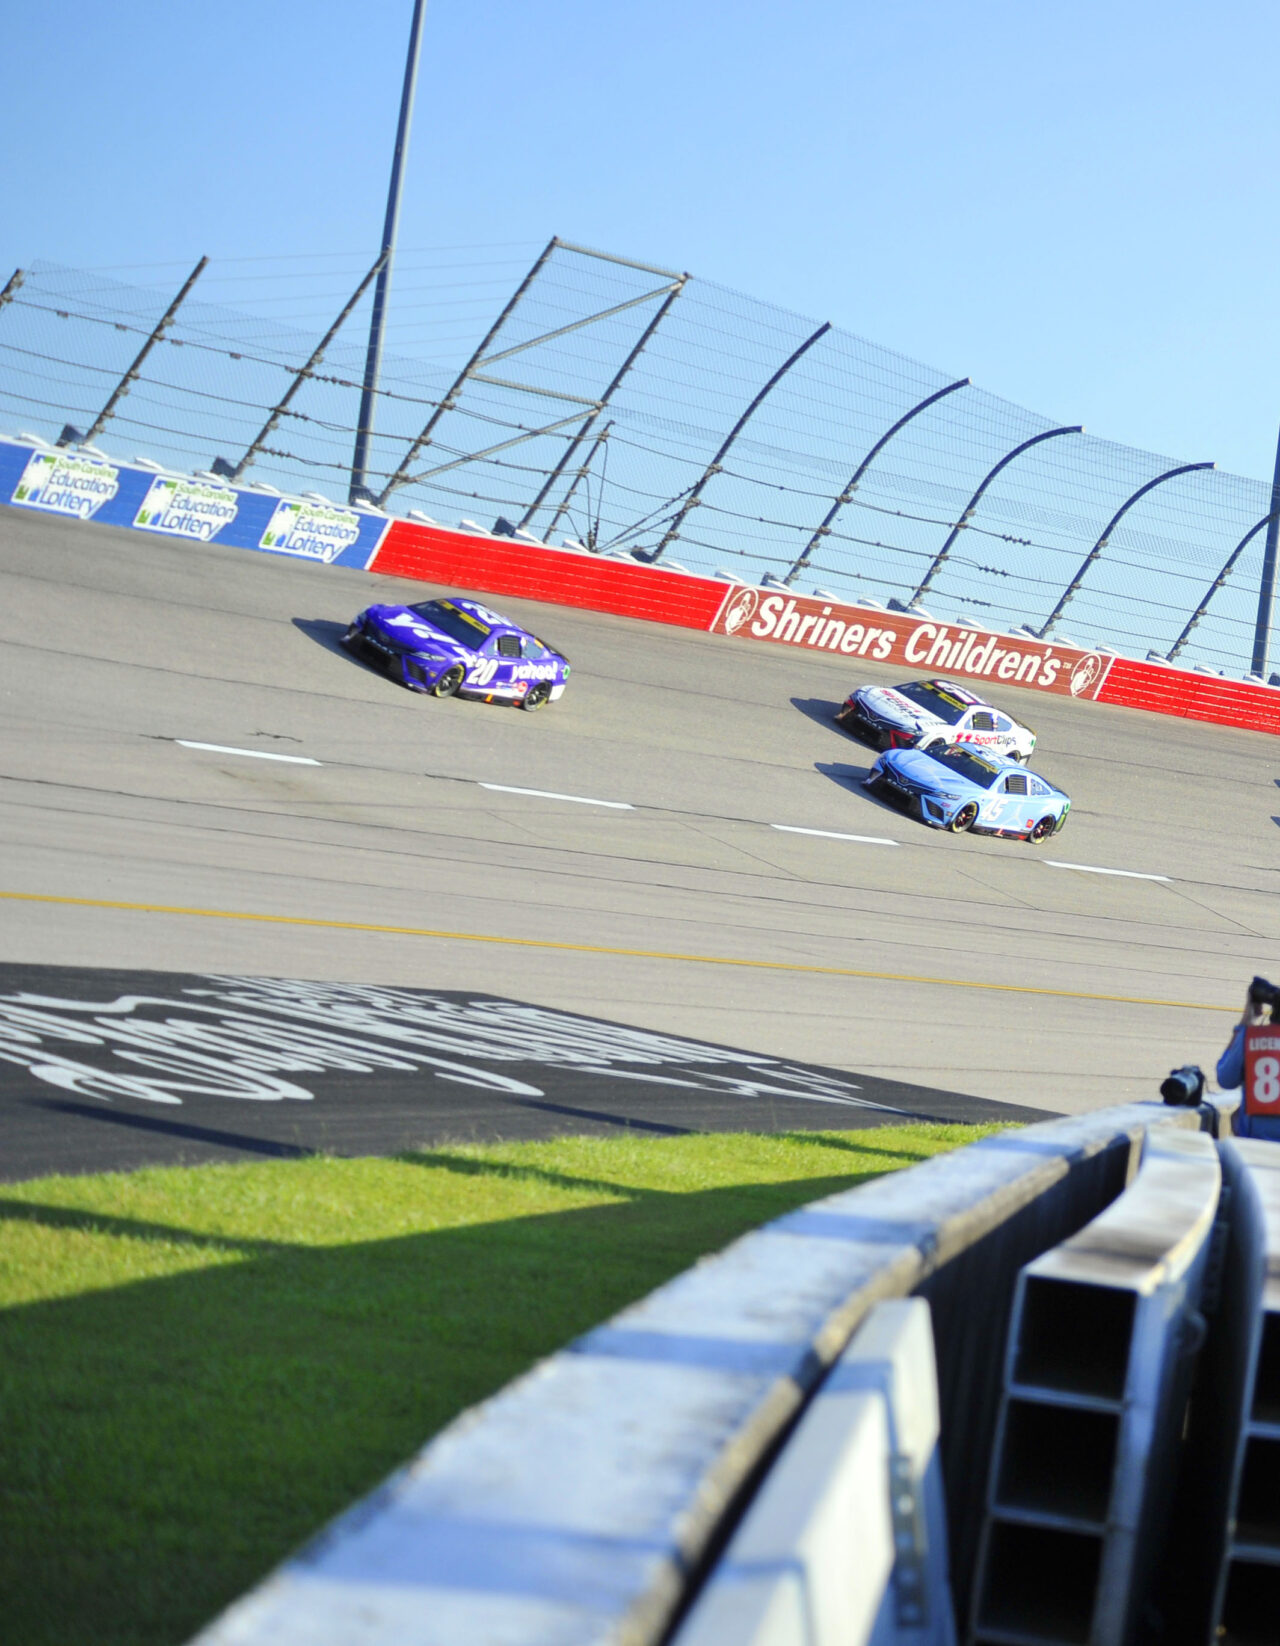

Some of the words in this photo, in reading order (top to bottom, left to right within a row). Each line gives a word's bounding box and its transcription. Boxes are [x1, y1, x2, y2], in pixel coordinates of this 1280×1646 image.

[50, 468, 116, 496] Education
[40, 485, 98, 514] Lottery
[170, 493, 235, 519] Education
[161, 509, 220, 536] Lottery
[295, 516, 358, 541] Education
[285, 532, 342, 559] Lottery
[751, 595, 898, 660] Shriners
[904, 623, 1062, 687] Children's
[466, 658, 499, 686] 20
[510, 661, 558, 682] yahoo!
